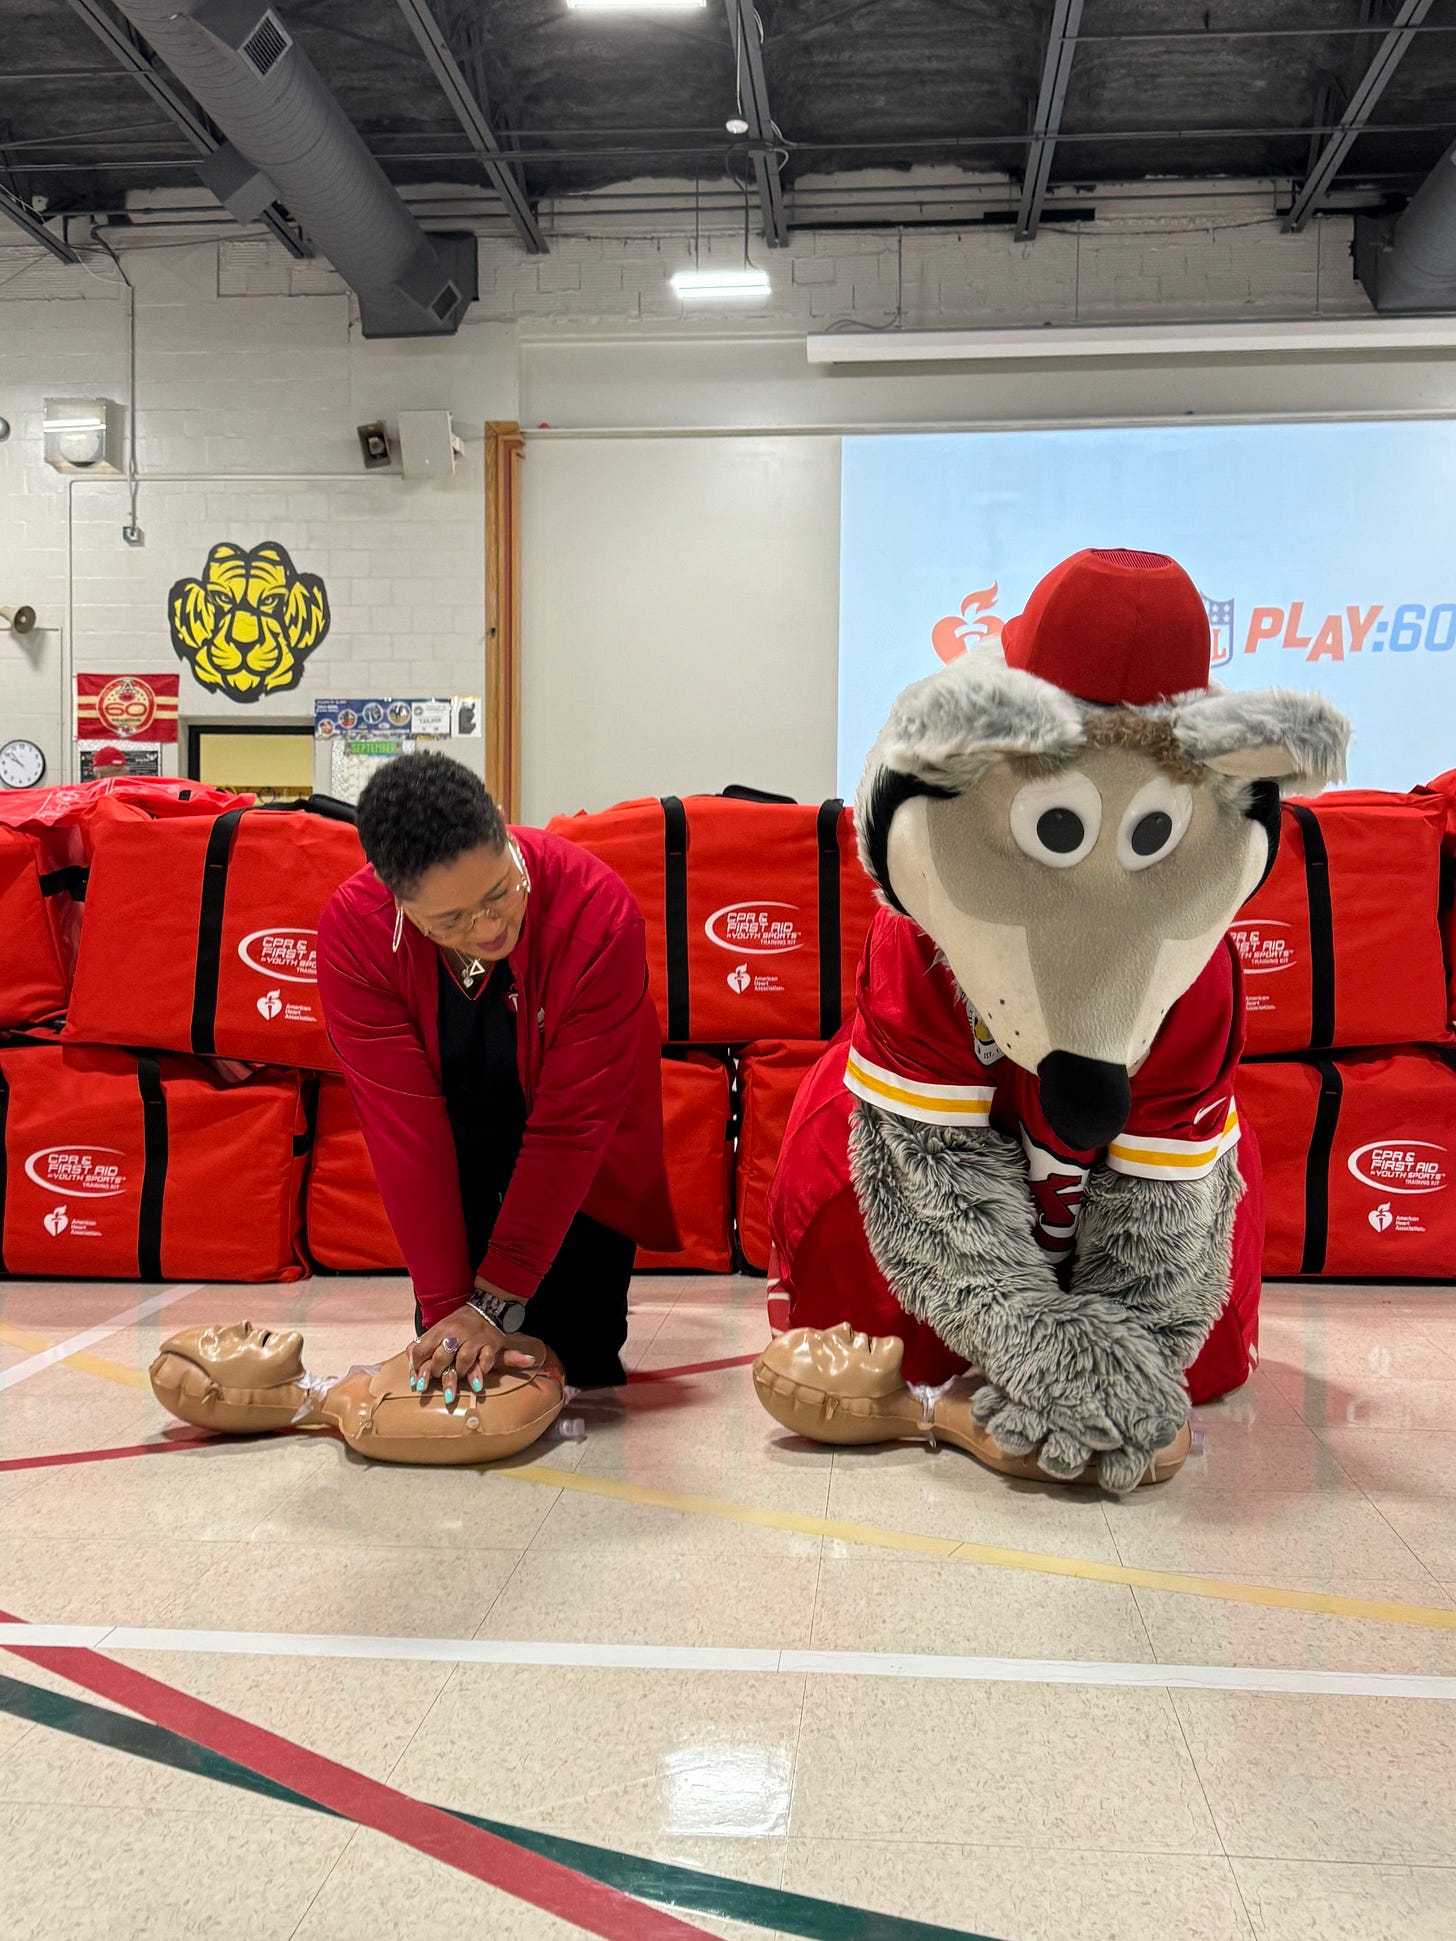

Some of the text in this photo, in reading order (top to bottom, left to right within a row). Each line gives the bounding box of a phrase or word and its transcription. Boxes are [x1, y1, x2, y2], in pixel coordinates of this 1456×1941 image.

[1244, 601, 1456, 662] PLAY:60
[105, 702, 147, 717] 60
[727, 912, 768, 923] CPR &
[726, 922, 793, 933] FIRST AID
[262, 936, 294, 950] CPR
[1262, 939, 1285, 951] AID
[261, 947, 307, 960] FIRST
[267, 956, 298, 967] YOUTH
[47, 1154, 92, 1166] CPR &
[1371, 1149, 1415, 1162] CPR &
[47, 1163, 118, 1177] FIRST AID
[1370, 1160, 1439, 1173] FIRST AID
[53, 1173, 84, 1181] YOUTH
[1375, 1170, 1407, 1179] YOUTH
